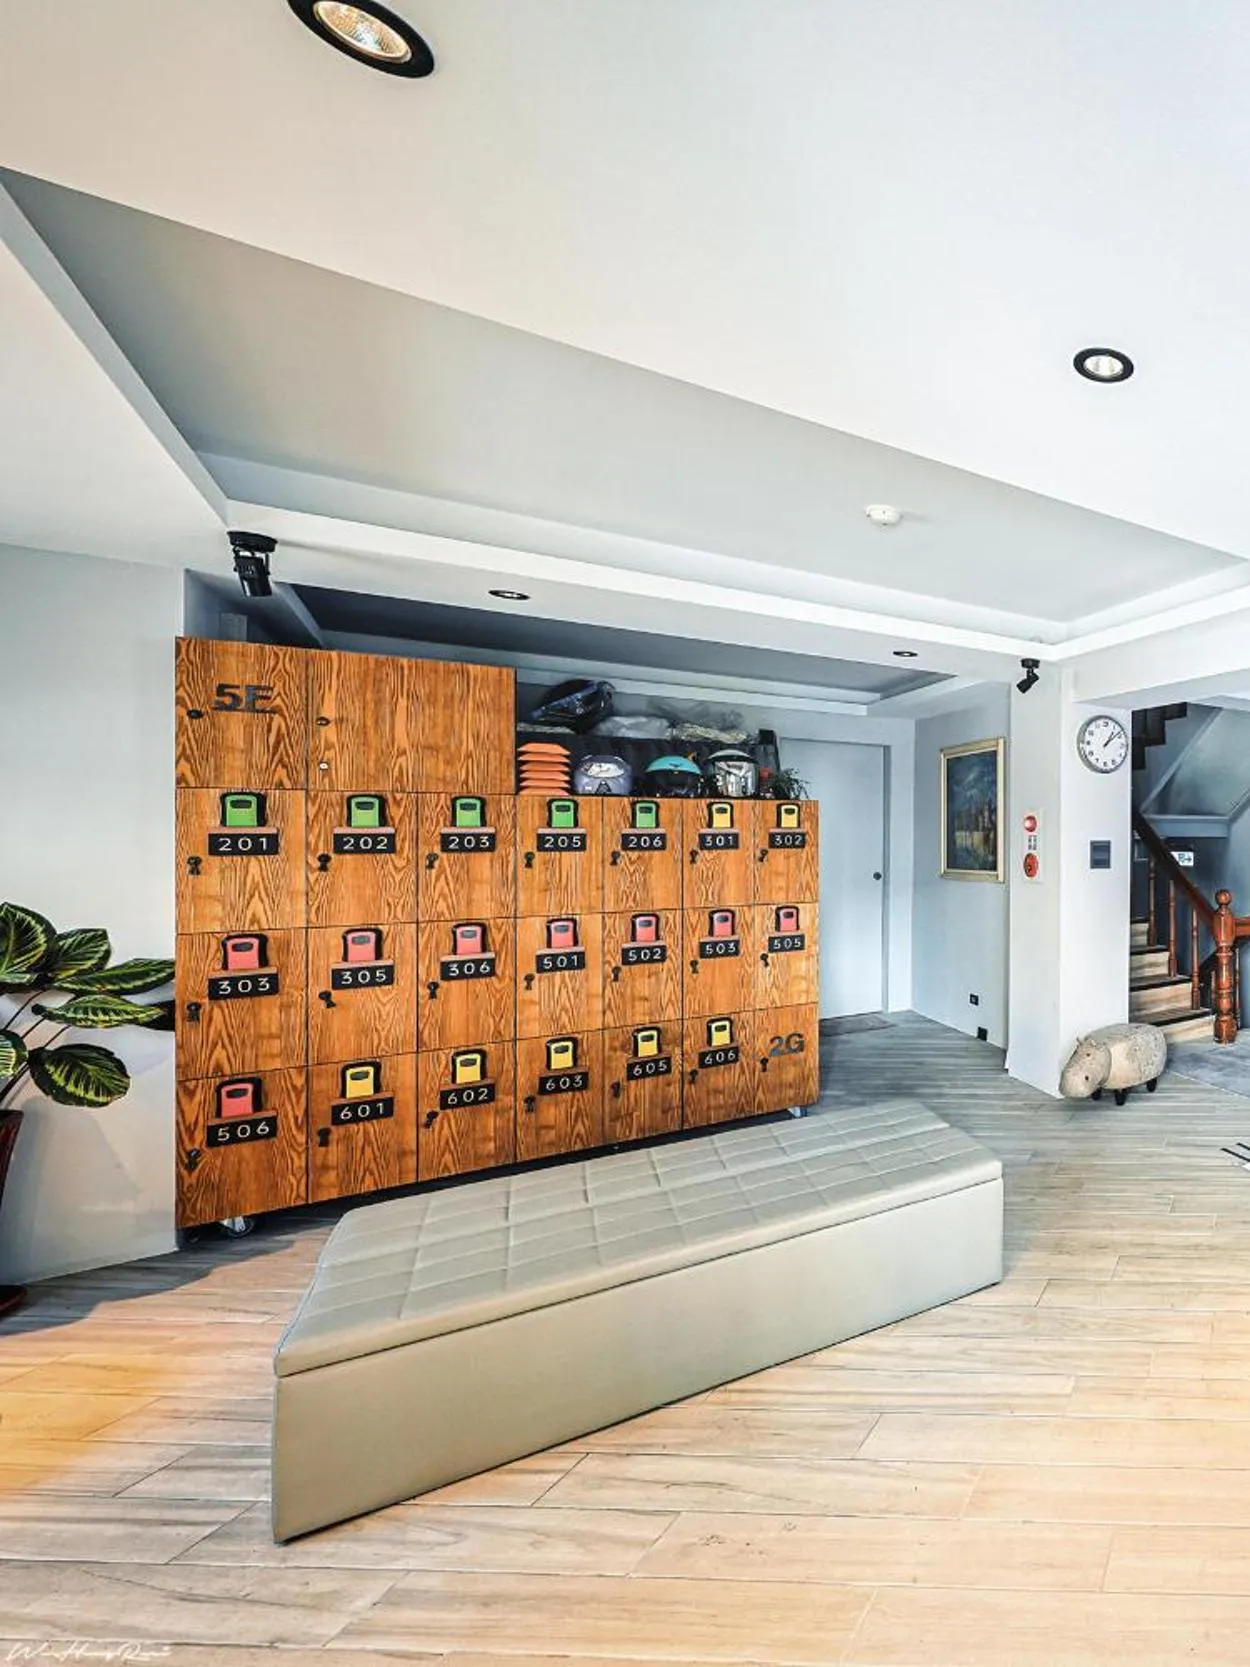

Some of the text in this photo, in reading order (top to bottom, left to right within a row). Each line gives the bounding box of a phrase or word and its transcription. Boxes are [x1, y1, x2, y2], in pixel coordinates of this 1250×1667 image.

[219, 837, 267, 851] 201
[343, 836, 388, 850] 202
[448, 835, 490, 849] 203
[544, 835, 581, 848] 205
[628, 836, 663, 848] 206
[705, 833, 734, 846] 301
[774, 832, 802, 845] 302
[705, 942, 736, 955] 503
[773, 937, 802, 950] 505
[543, 954, 578, 969] 501
[628, 947, 661, 962] 502
[449, 960, 491, 976] 306
[341, 966, 387, 985] 305
[218, 977, 270, 995] 303
[768, 1032, 805, 1057] 2G
[704, 1050, 736, 1064] 606
[633, 1060, 667, 1076] 605
[546, 1075, 582, 1089] 603
[448, 1088, 488, 1104] 602
[340, 1102, 383, 1120] 601
[218, 1121, 270, 1141] 506
